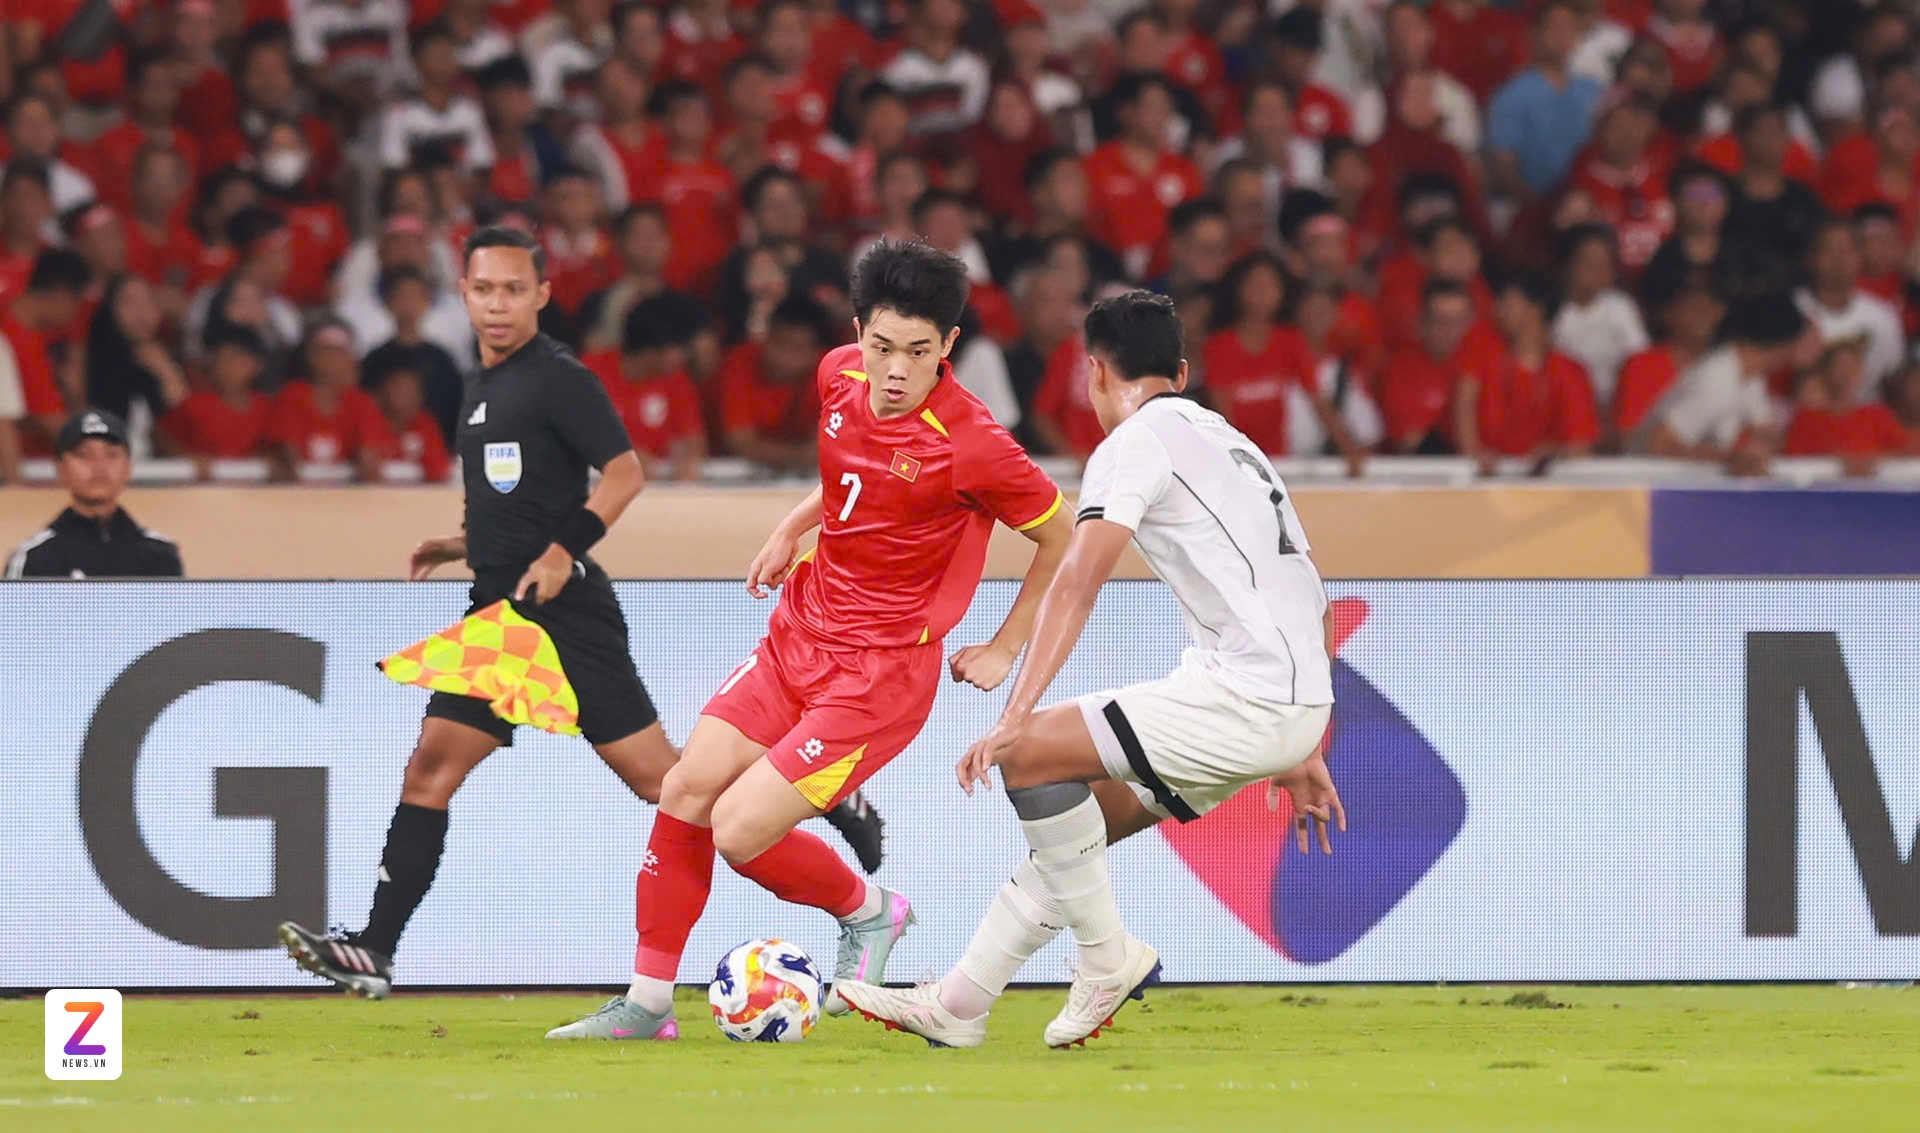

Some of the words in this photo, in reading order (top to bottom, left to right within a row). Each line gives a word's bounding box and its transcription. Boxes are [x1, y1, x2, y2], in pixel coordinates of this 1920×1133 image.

[489, 447, 516, 458] FIFA
[838, 472, 863, 522] 7
[1229, 448, 1300, 555] 2
[78, 627, 328, 950] G
[1745, 631, 1920, 937] M
